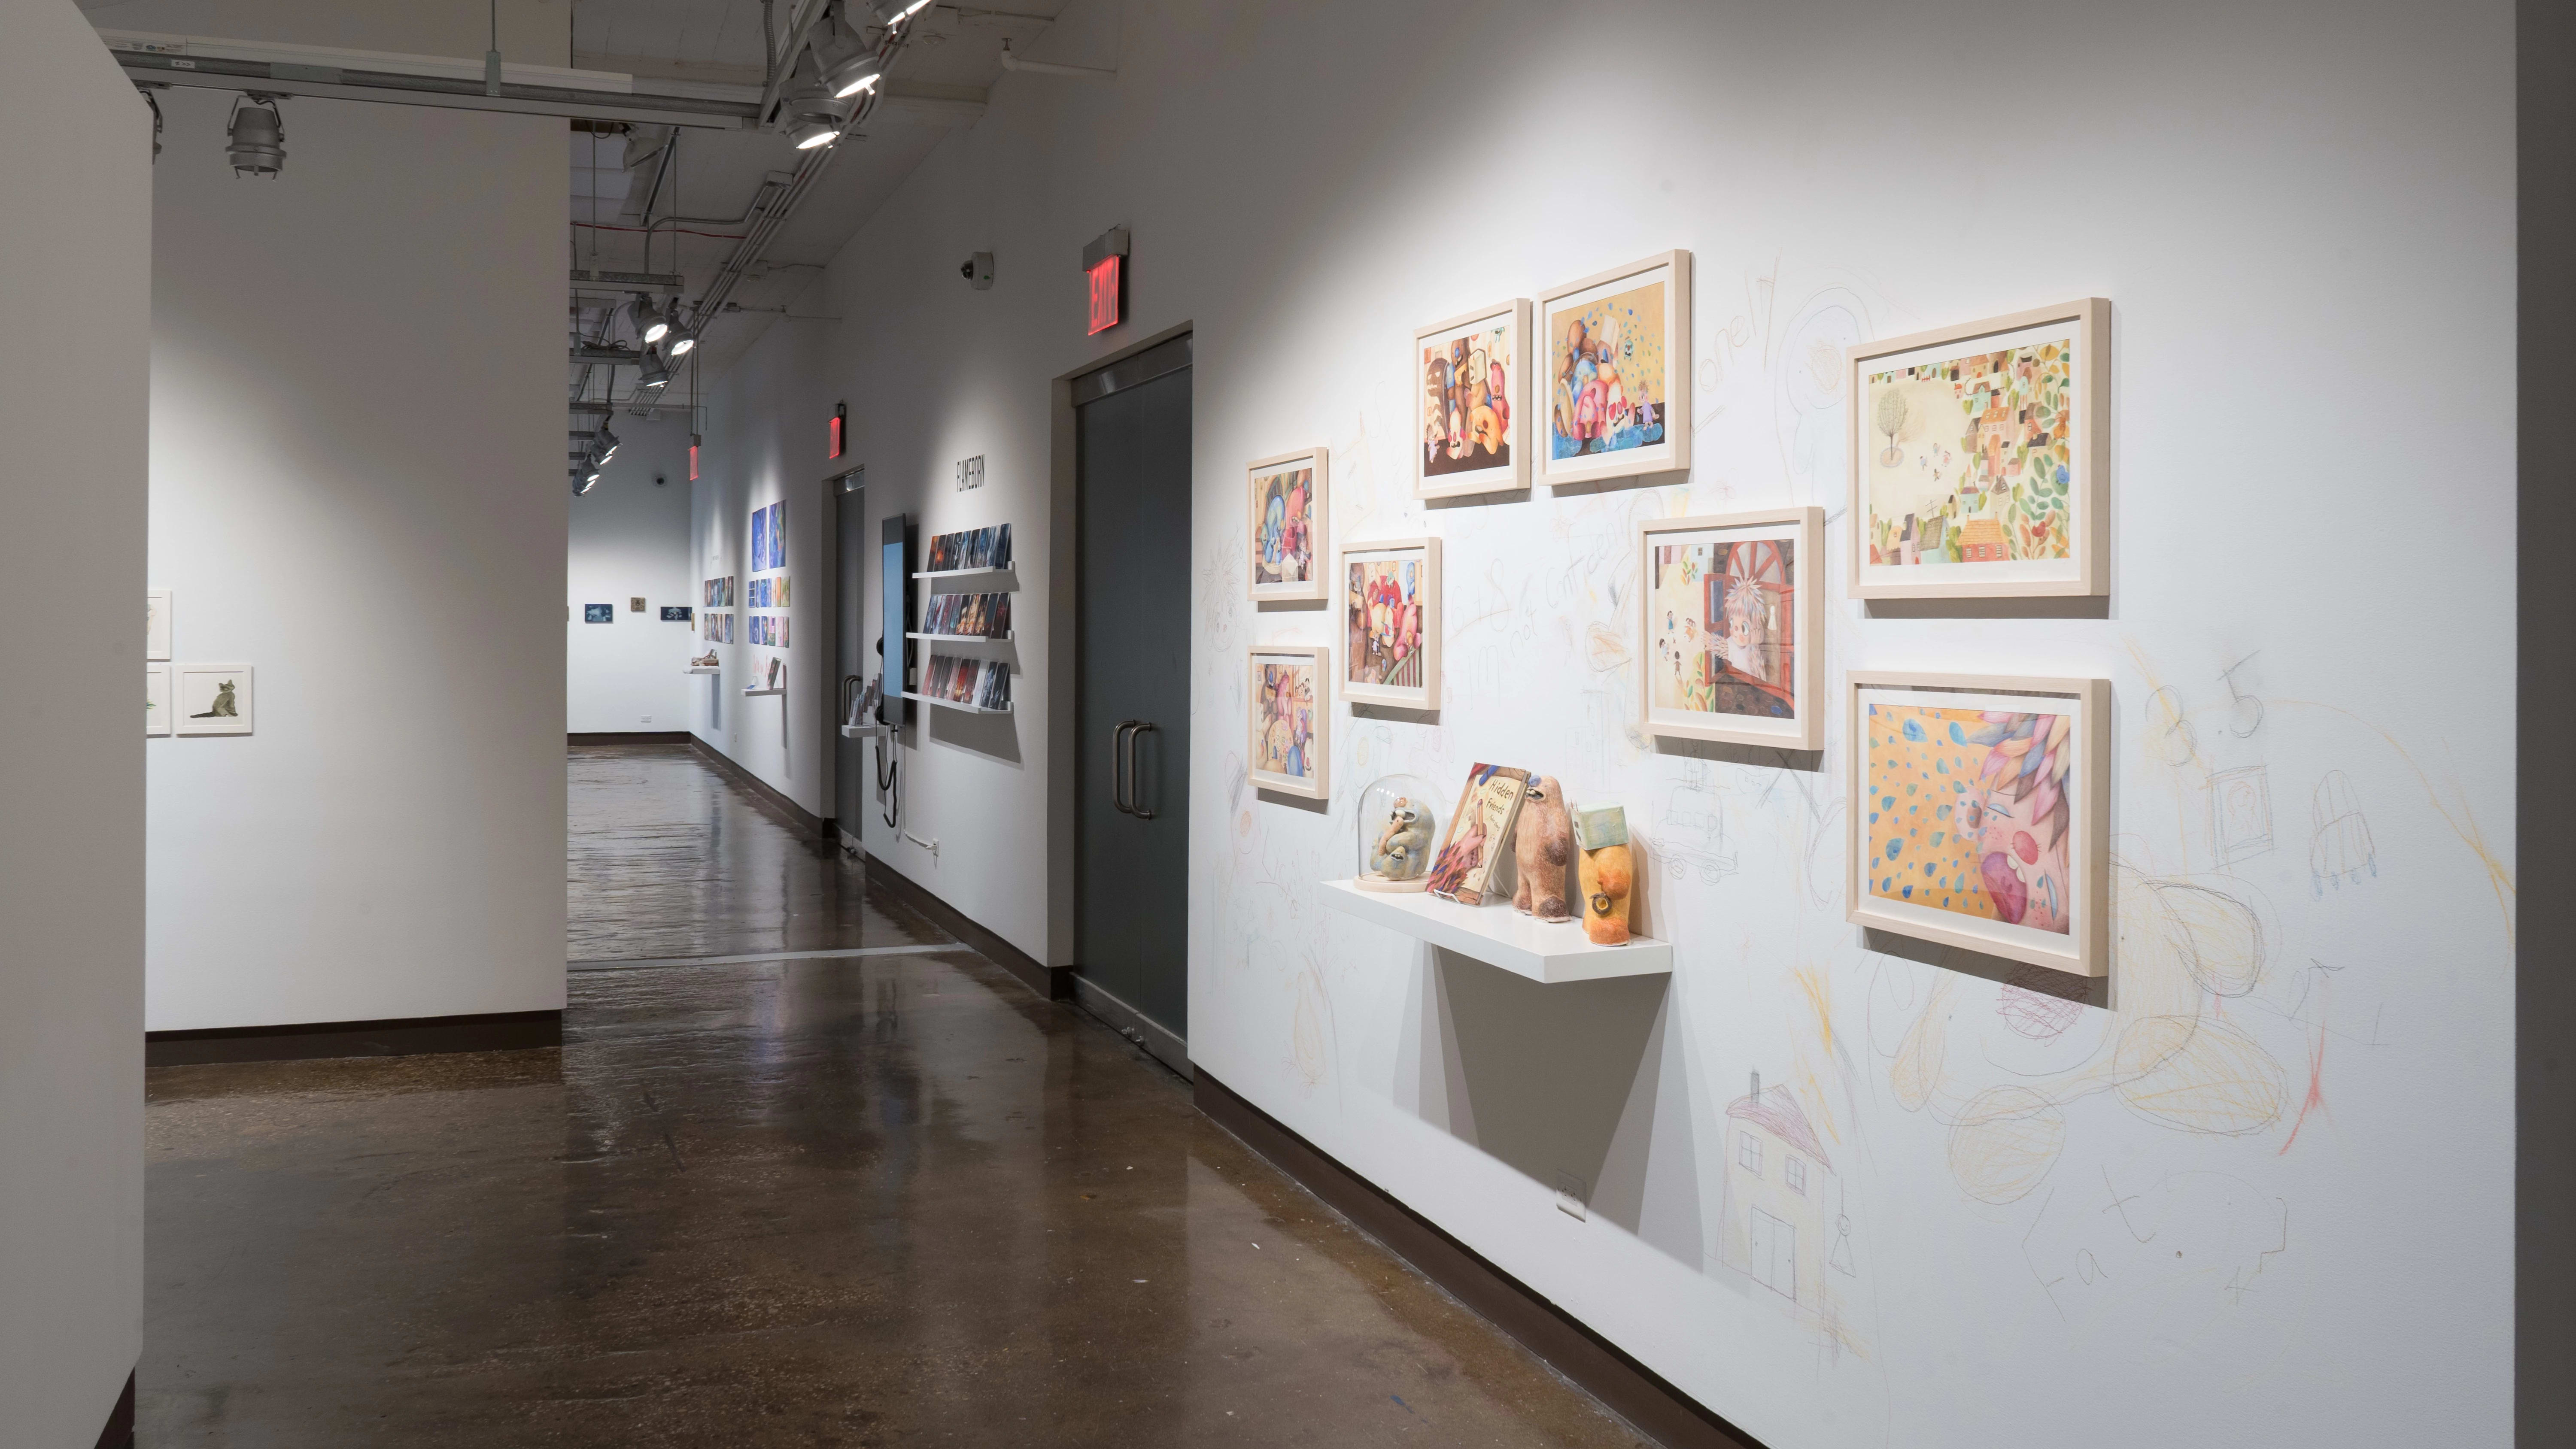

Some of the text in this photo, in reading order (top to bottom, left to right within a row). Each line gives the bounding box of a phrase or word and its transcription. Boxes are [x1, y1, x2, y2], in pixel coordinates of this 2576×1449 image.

[1091, 260, 1115, 329] EXIT
[957, 454, 984, 492] FLAMEBORN
[1489, 778, 1514, 800] Hidden
[1485, 797, 1505, 815] Friends
